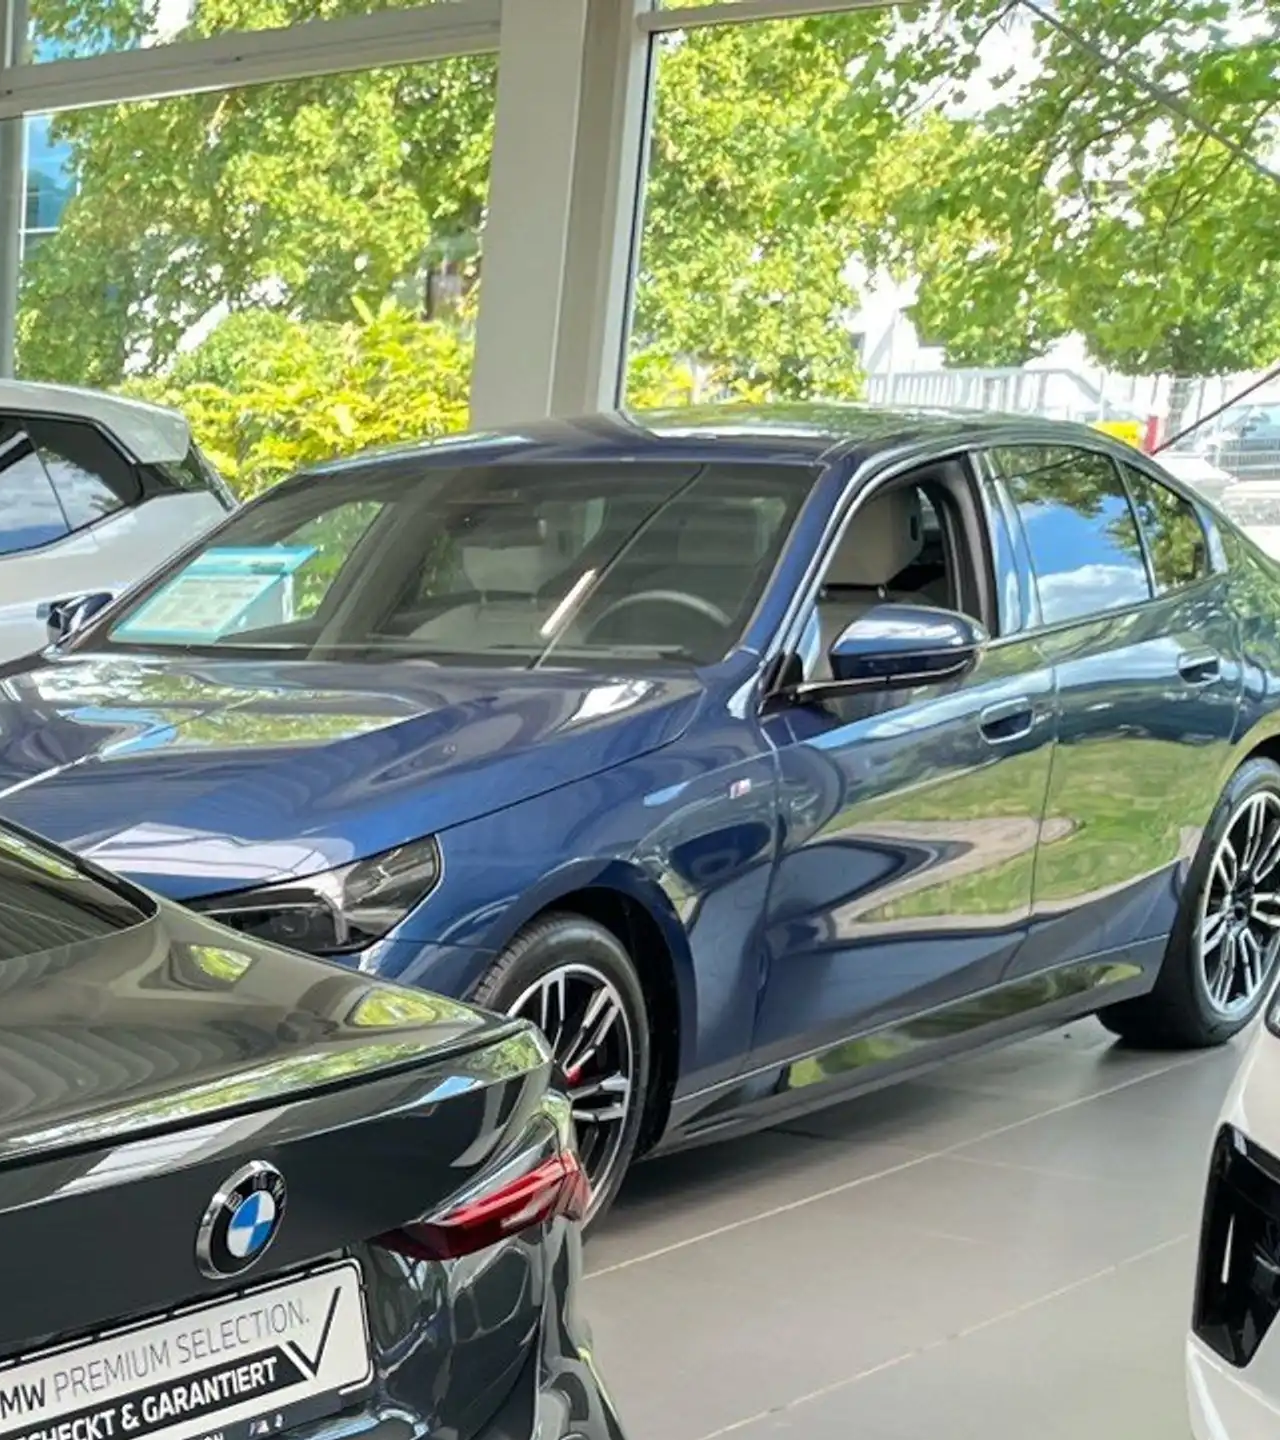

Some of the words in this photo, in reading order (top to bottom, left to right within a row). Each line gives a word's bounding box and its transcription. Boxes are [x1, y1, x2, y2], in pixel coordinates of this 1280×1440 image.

[53, 1339, 171, 1403] PREMIUM
[121, 1402, 140, 1431] &
[142, 1356, 278, 1423] GARANTIERT
